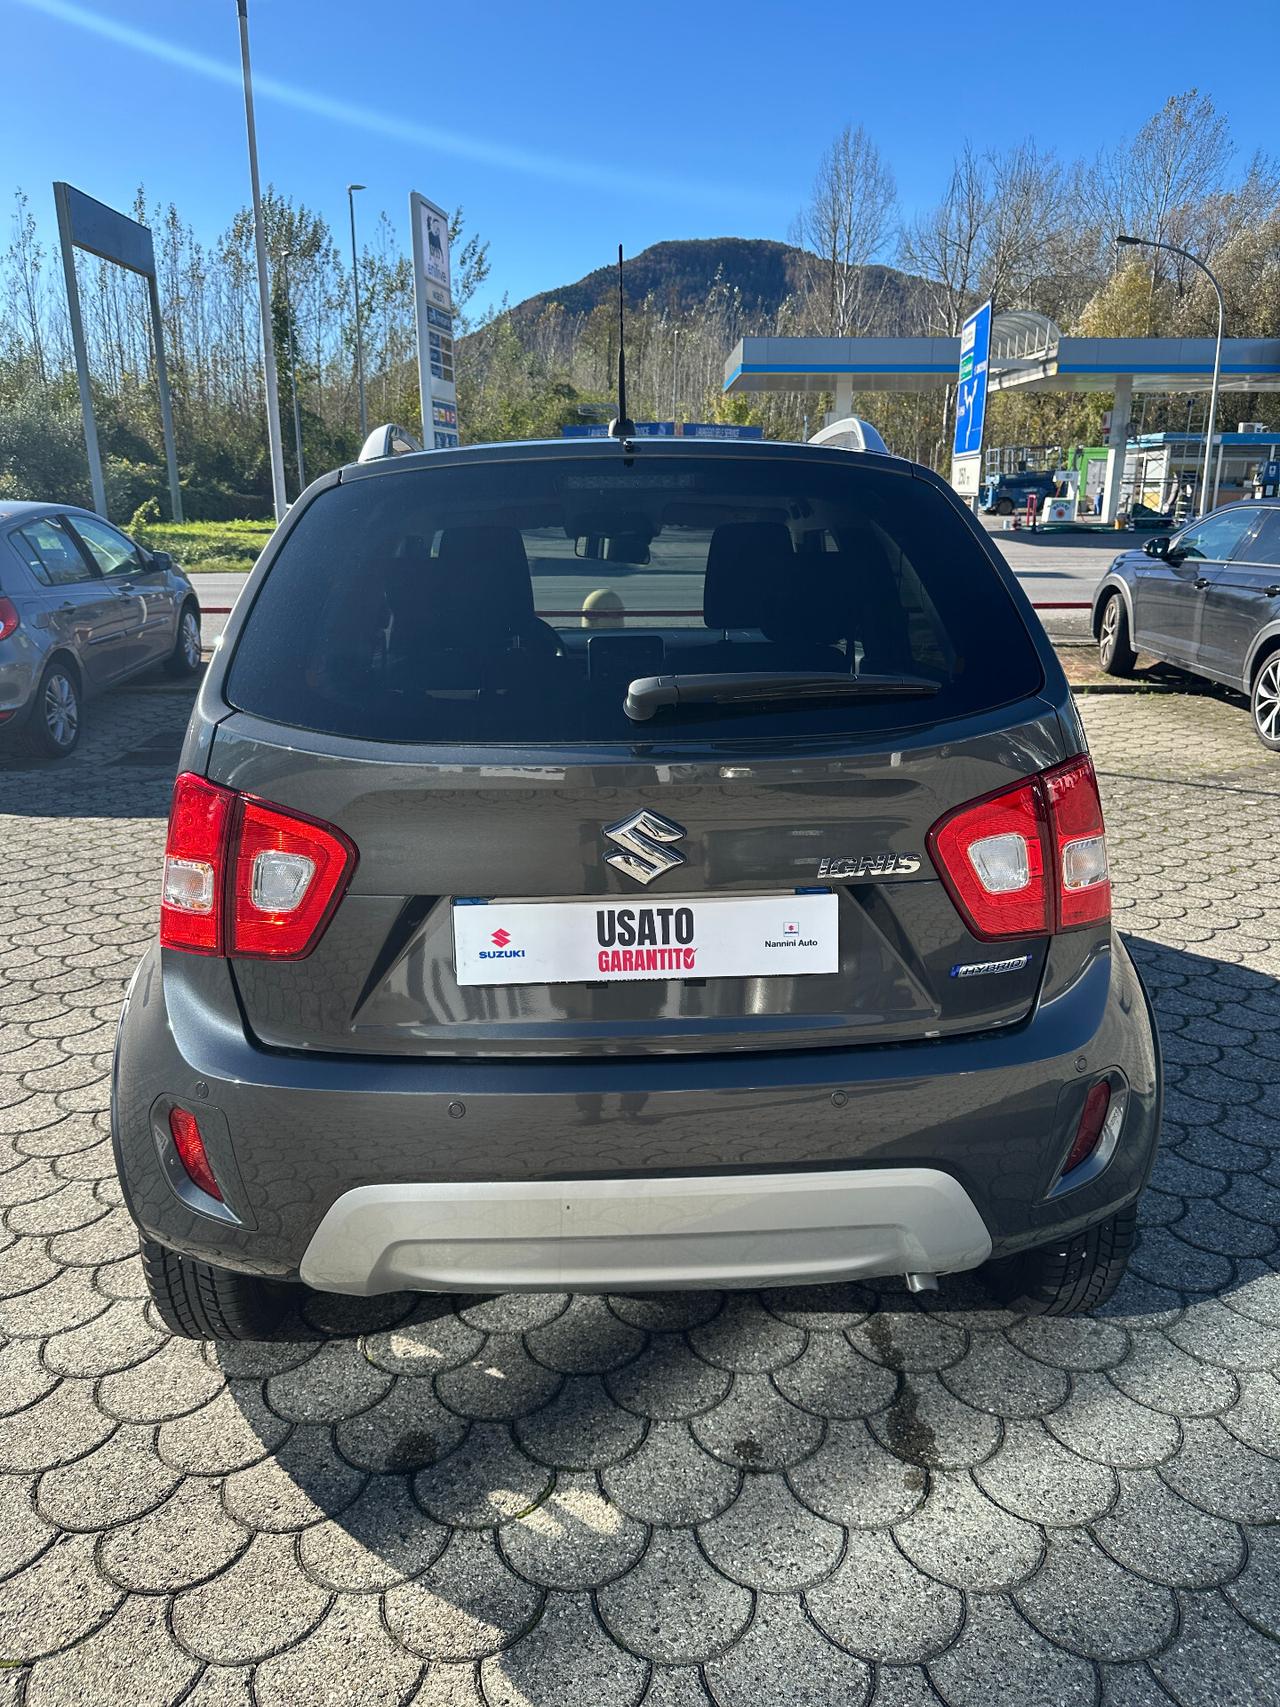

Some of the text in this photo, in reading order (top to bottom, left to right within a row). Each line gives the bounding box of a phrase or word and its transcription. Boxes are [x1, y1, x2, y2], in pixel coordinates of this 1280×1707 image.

[817, 852, 922, 878] IGNIS
[597, 907, 694, 947] USATO
[479, 949, 525, 959] SUZUKI
[764, 939, 818, 948] Nannini Auto
[598, 948, 696, 973] GARANTITO
[960, 958, 1026, 976] HYBRID
